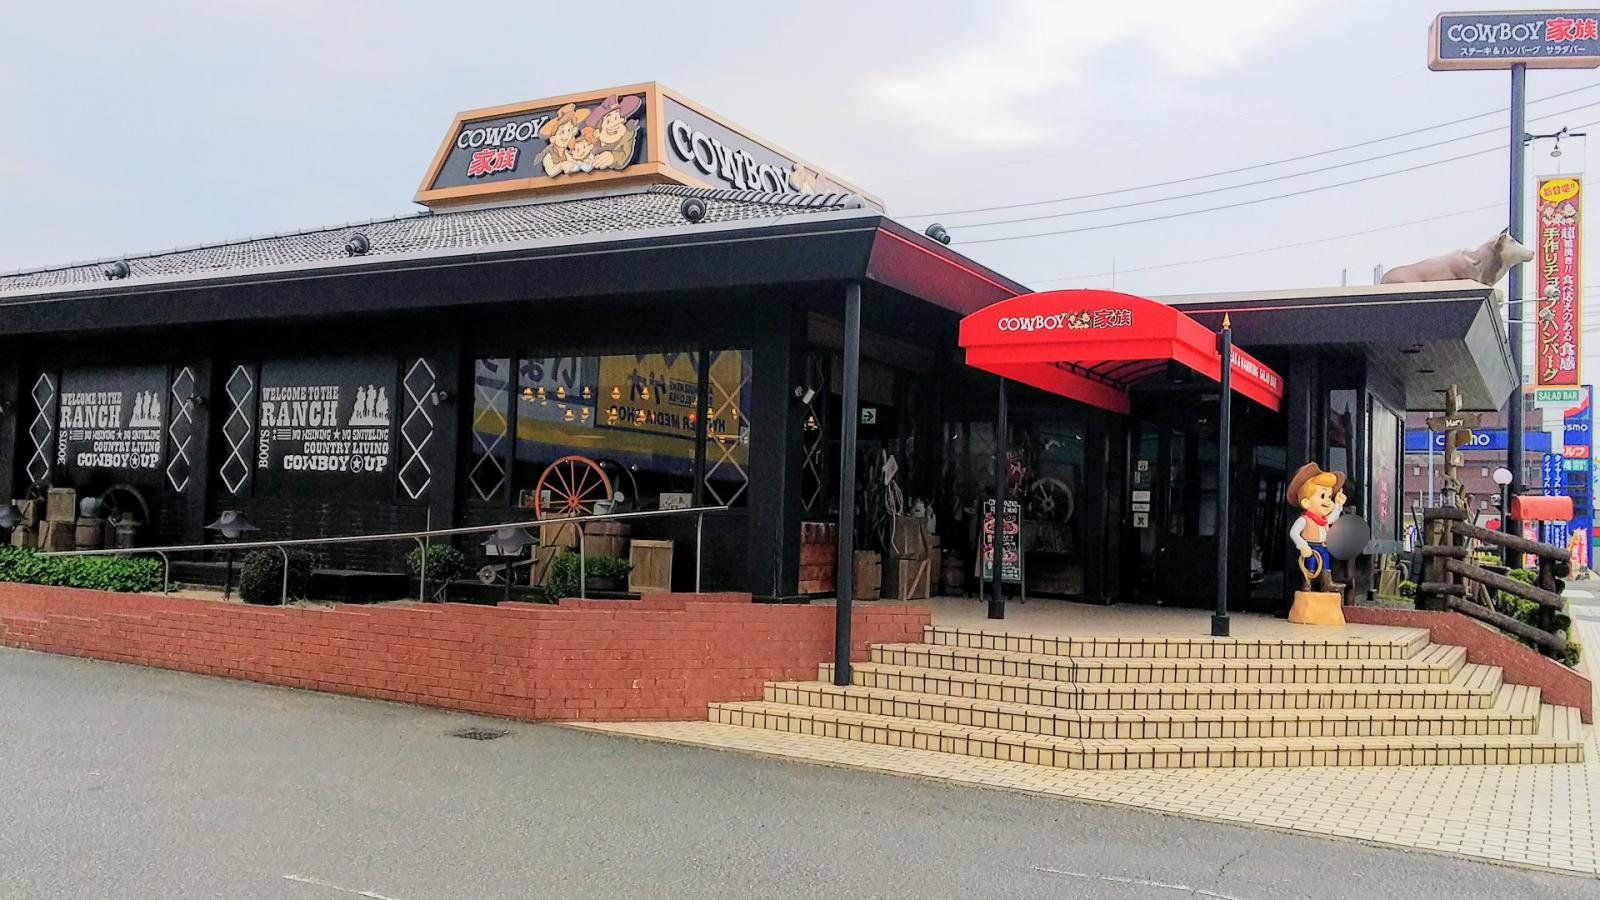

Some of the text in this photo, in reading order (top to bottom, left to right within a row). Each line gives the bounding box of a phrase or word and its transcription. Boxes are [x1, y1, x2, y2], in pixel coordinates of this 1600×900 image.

[1447, 17, 1598, 43] COWBOY 家族
[1546, 45, 1586, 55] サラダバー
[457, 116, 550, 149] COWBOY
[467, 146, 519, 176] 家族
[670, 120, 792, 195] COWBOY
[997, 308, 1133, 332] COWBOY 家族
[61, 392, 97, 405] WELCOME
[262, 386, 339, 401] WELCOME TO THE
[1538, 391, 1578, 401] SALAD BAR
[60, 405, 121, 428] RANCH
[261, 401, 338, 427] RANCH
[94, 441, 160, 453] COUNTRY LIVING
[258, 429, 270, 469] BOOTS
[304, 442, 389, 455] COUNTRY LIVING
[1563, 447, 1585, 457] ルフ
[77, 453, 159, 467] COWBOY UP
[283, 455, 387, 471] COWBOY UP
